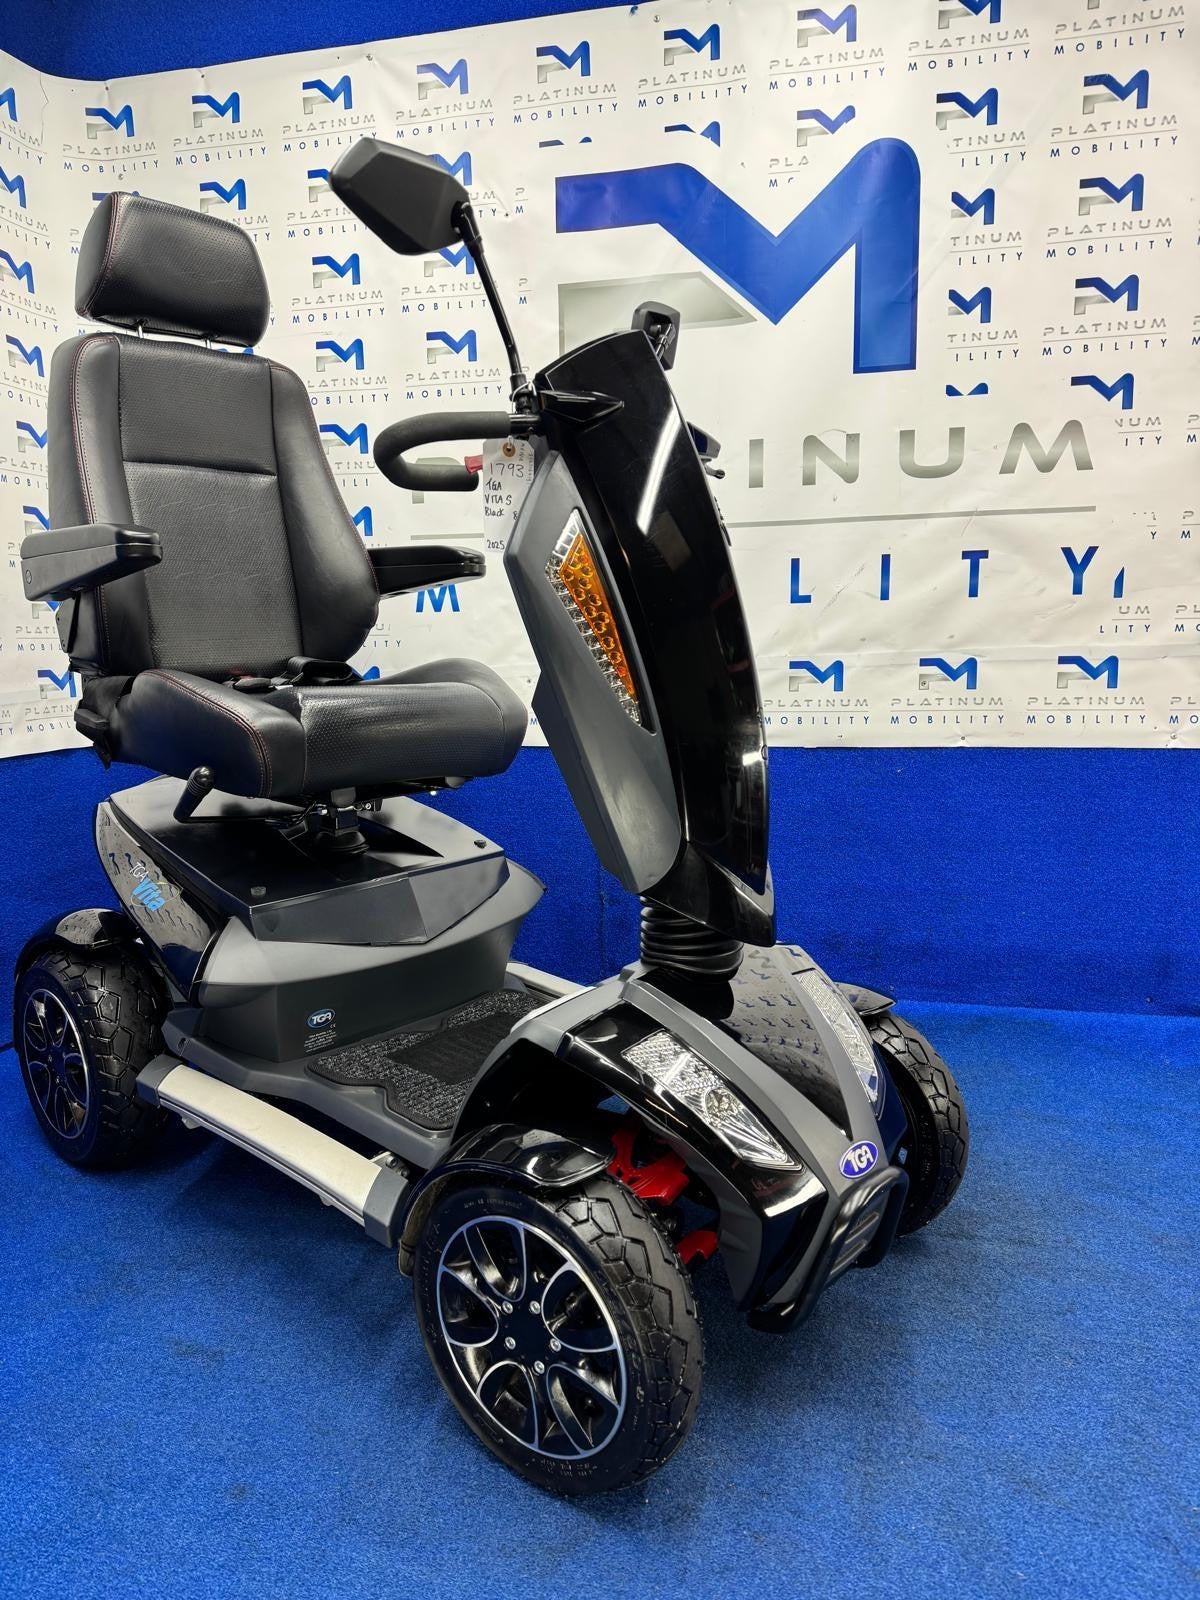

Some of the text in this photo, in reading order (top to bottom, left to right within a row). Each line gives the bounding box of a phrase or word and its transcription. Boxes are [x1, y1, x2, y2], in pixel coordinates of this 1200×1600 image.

[1055, 5, 1184, 35] PLATINUM
[908, 28, 1029, 51] PLATINUM
[1054, 28, 1185, 55] MOBILITY
[769, 48, 884, 70] PLATINUM
[907, 49, 1030, 72] MOBILITY
[638, 64, 746, 89] PLATINUM
[769, 68, 885, 91] MOBILITY
[513, 83, 617, 105] PLATINUM
[638, 84, 748, 108] MOBILITY
[395, 98, 493, 120] PLATINUM
[513, 102, 618, 124] MOBILITY
[282, 113, 376, 135] PLATINUM
[396, 117, 495, 139] MOBILITY
[1051, 114, 1177, 137] PLATINUM
[2, 120, 41, 146] INUM
[173, 128, 264, 147] PLATINUM
[953, 131, 1025, 148] TINUM
[62, 141, 156, 156] PLATINUM
[283, 132, 377, 152] MOBILIY
[1050, 135, 1178, 158] MOBILITY
[175, 147, 266, 166] MOBILITY
[961, 151, 1026, 167] ILITY
[63, 160, 159, 173] MOBILITY
[0, 205, 48, 231] TINUM
[287, 207, 350, 221] PLATIN
[288, 223, 364, 239] MOBILI
[1047, 217, 1172, 238] PLATINUM
[1, 225, 51, 249] ILITY
[950, 231, 1022, 247] TINUM
[1046, 238, 1172, 258] MOBILITY
[958, 251, 1023, 266] ILITY
[1, 289, 56, 315] ATINUM
[291, 289, 383, 307] PLATINUM
[402, 298, 486, 313] MOBILIT
[292, 307, 385, 324] MOBILITY
[1043, 317, 1167, 336] PLATINUM
[947, 329, 1018, 343] TINUM
[955, 349, 1019, 362] ILITY
[1042, 338, 1167, 356] MOBILITY
[307, 375, 388, 388] LATINUM
[405, 367, 501, 382] PLATINUM
[311, 392, 389, 406] OBILITY
[406, 386, 502, 400] MOBILITY
[489, 463, 525, 479] 1793
[1, 474, 49, 490] MOBIL
[486, 539, 506, 550] 2025
[764, 697, 869, 708] PLATINUM
[890, 697, 1004, 706] PLATINUM
[1027, 696, 1145, 706] PLATINUM
[25, 704, 74, 716] PLATIN
[26, 722, 71, 733] MOBIL
[763, 715, 870, 726] MOBILITY
[890, 715, 1004, 725] MOBILITY
[1026, 715, 1146, 725] MOBILITY
